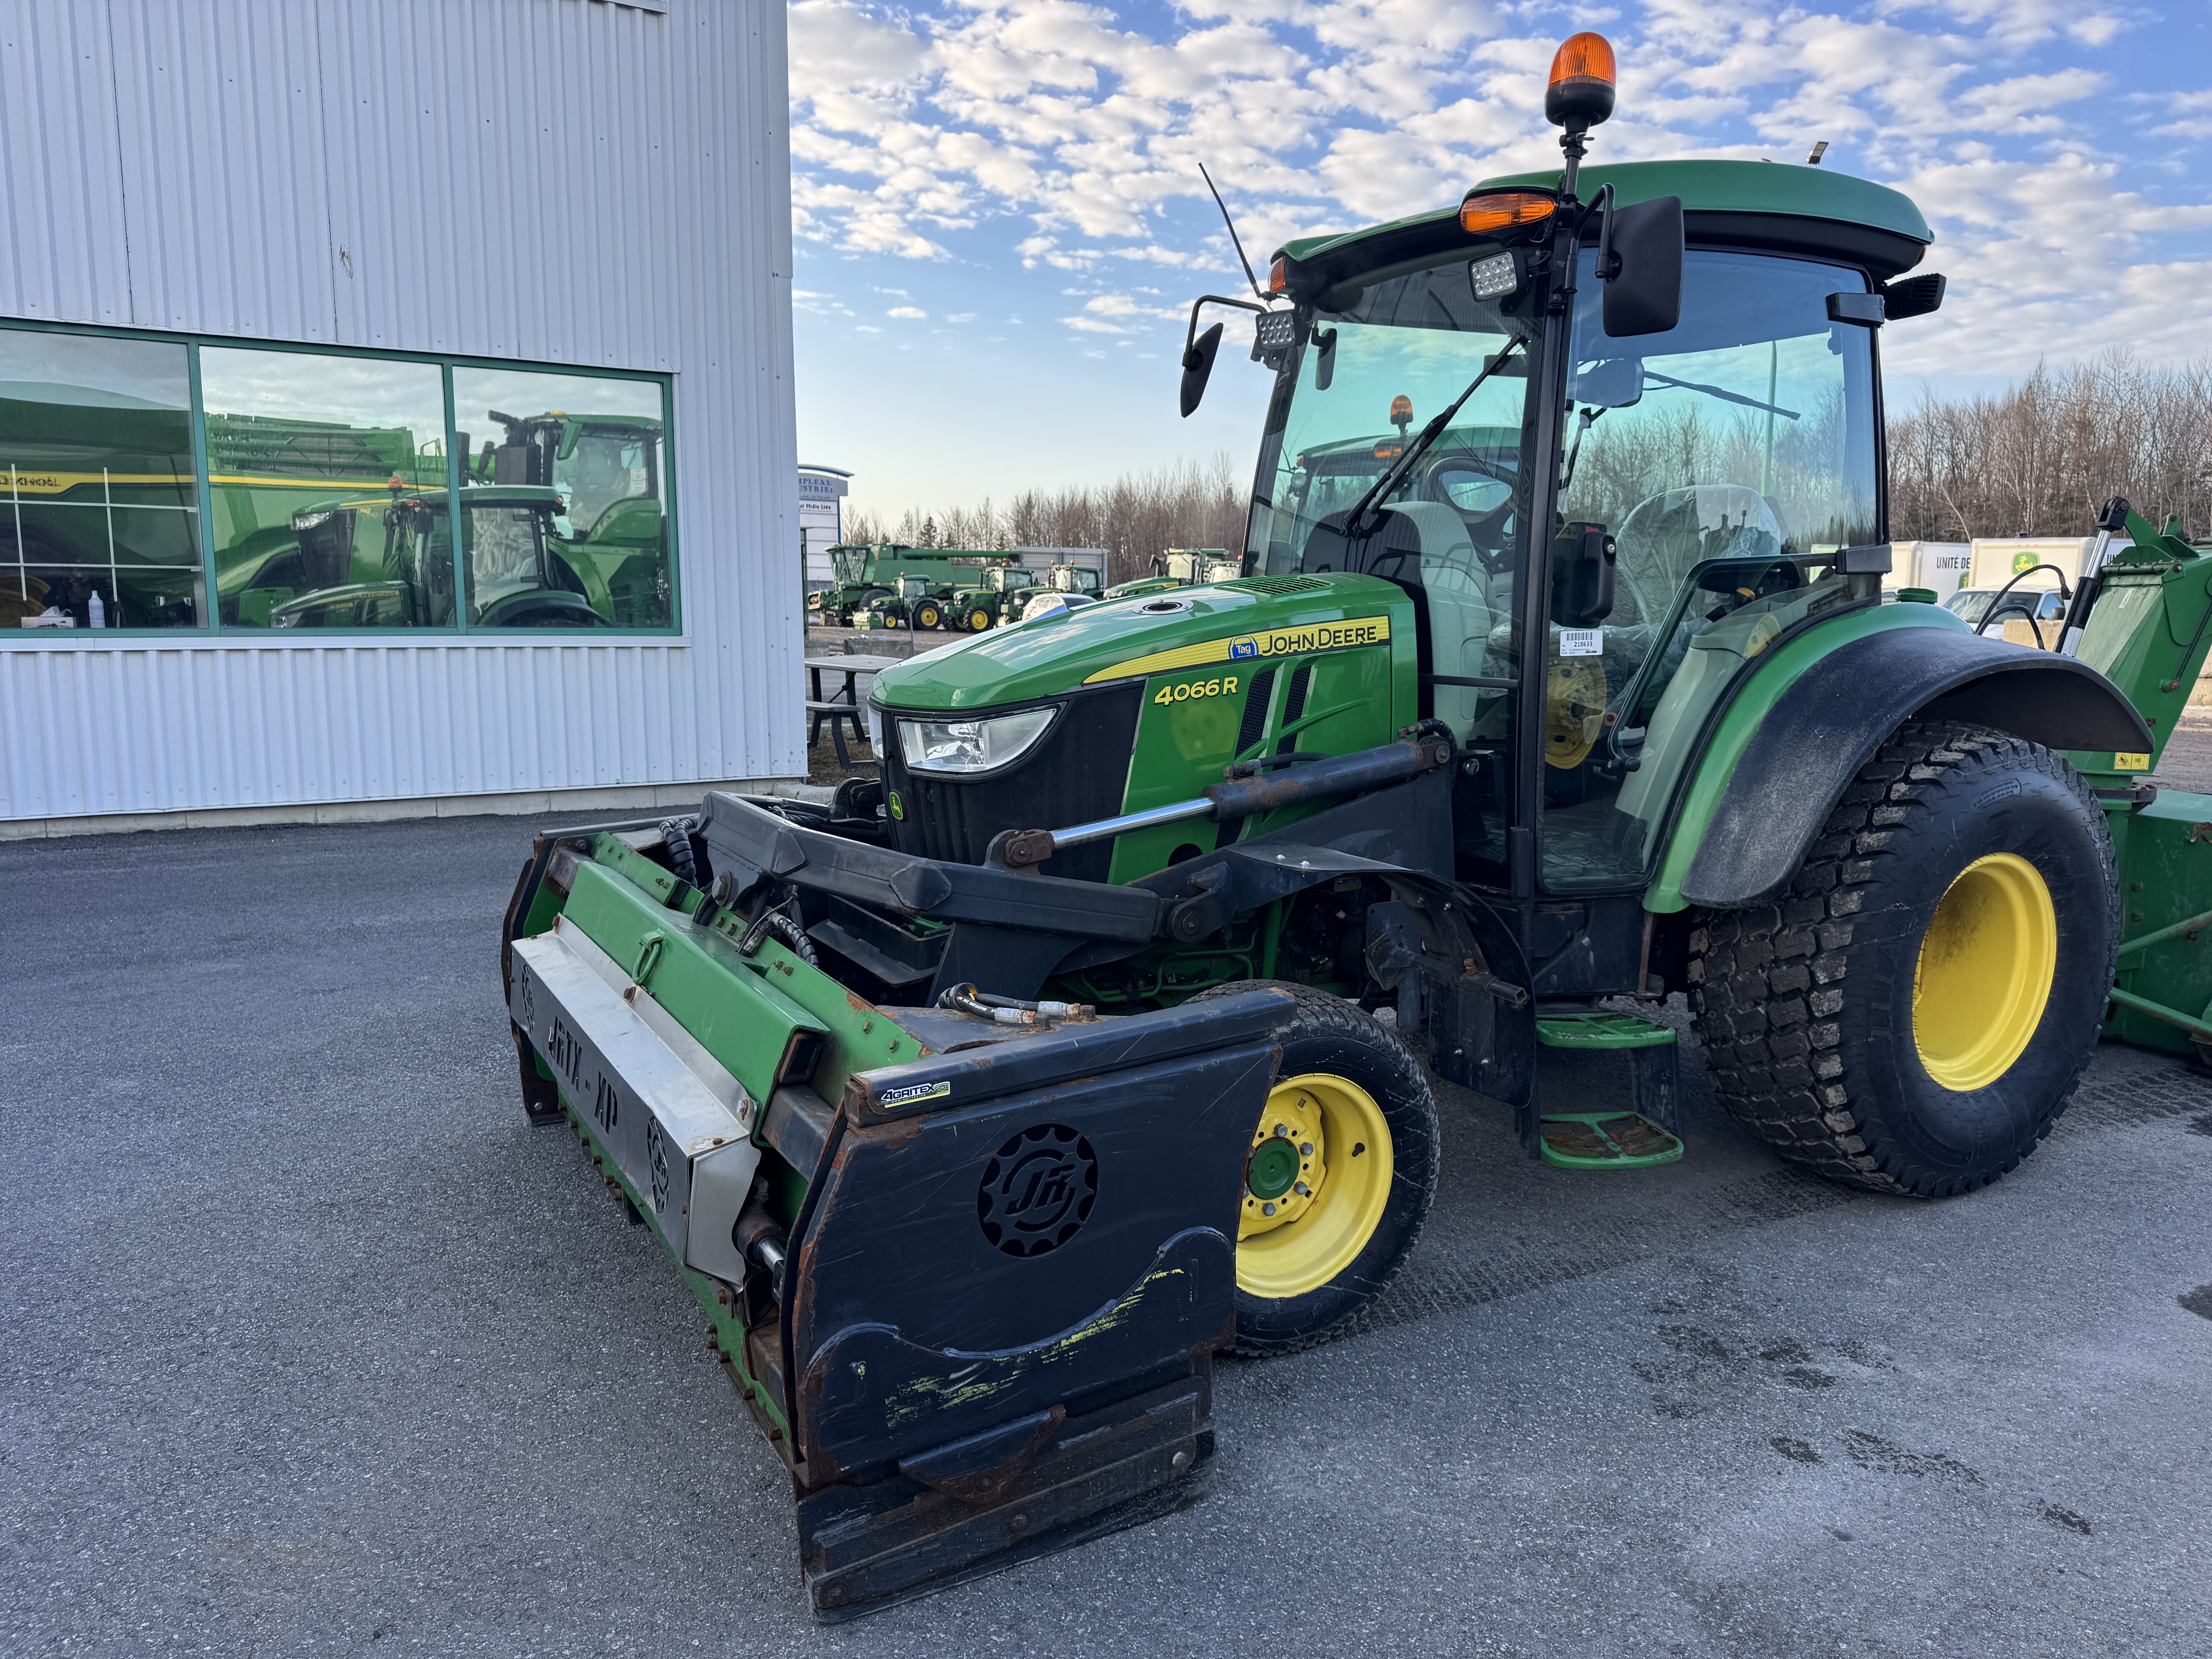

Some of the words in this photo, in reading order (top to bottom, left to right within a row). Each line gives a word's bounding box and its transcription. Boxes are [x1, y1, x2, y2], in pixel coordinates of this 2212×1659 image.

[1937, 554, 1959, 569] UNITÉ
[1961, 557, 1970, 569] DE
[1262, 633, 1314, 654] JOHN
[1318, 625, 1377, 647] DEERE
[1236, 644, 1251, 654] Tag
[883, 1085, 935, 1100] AGRITEX
